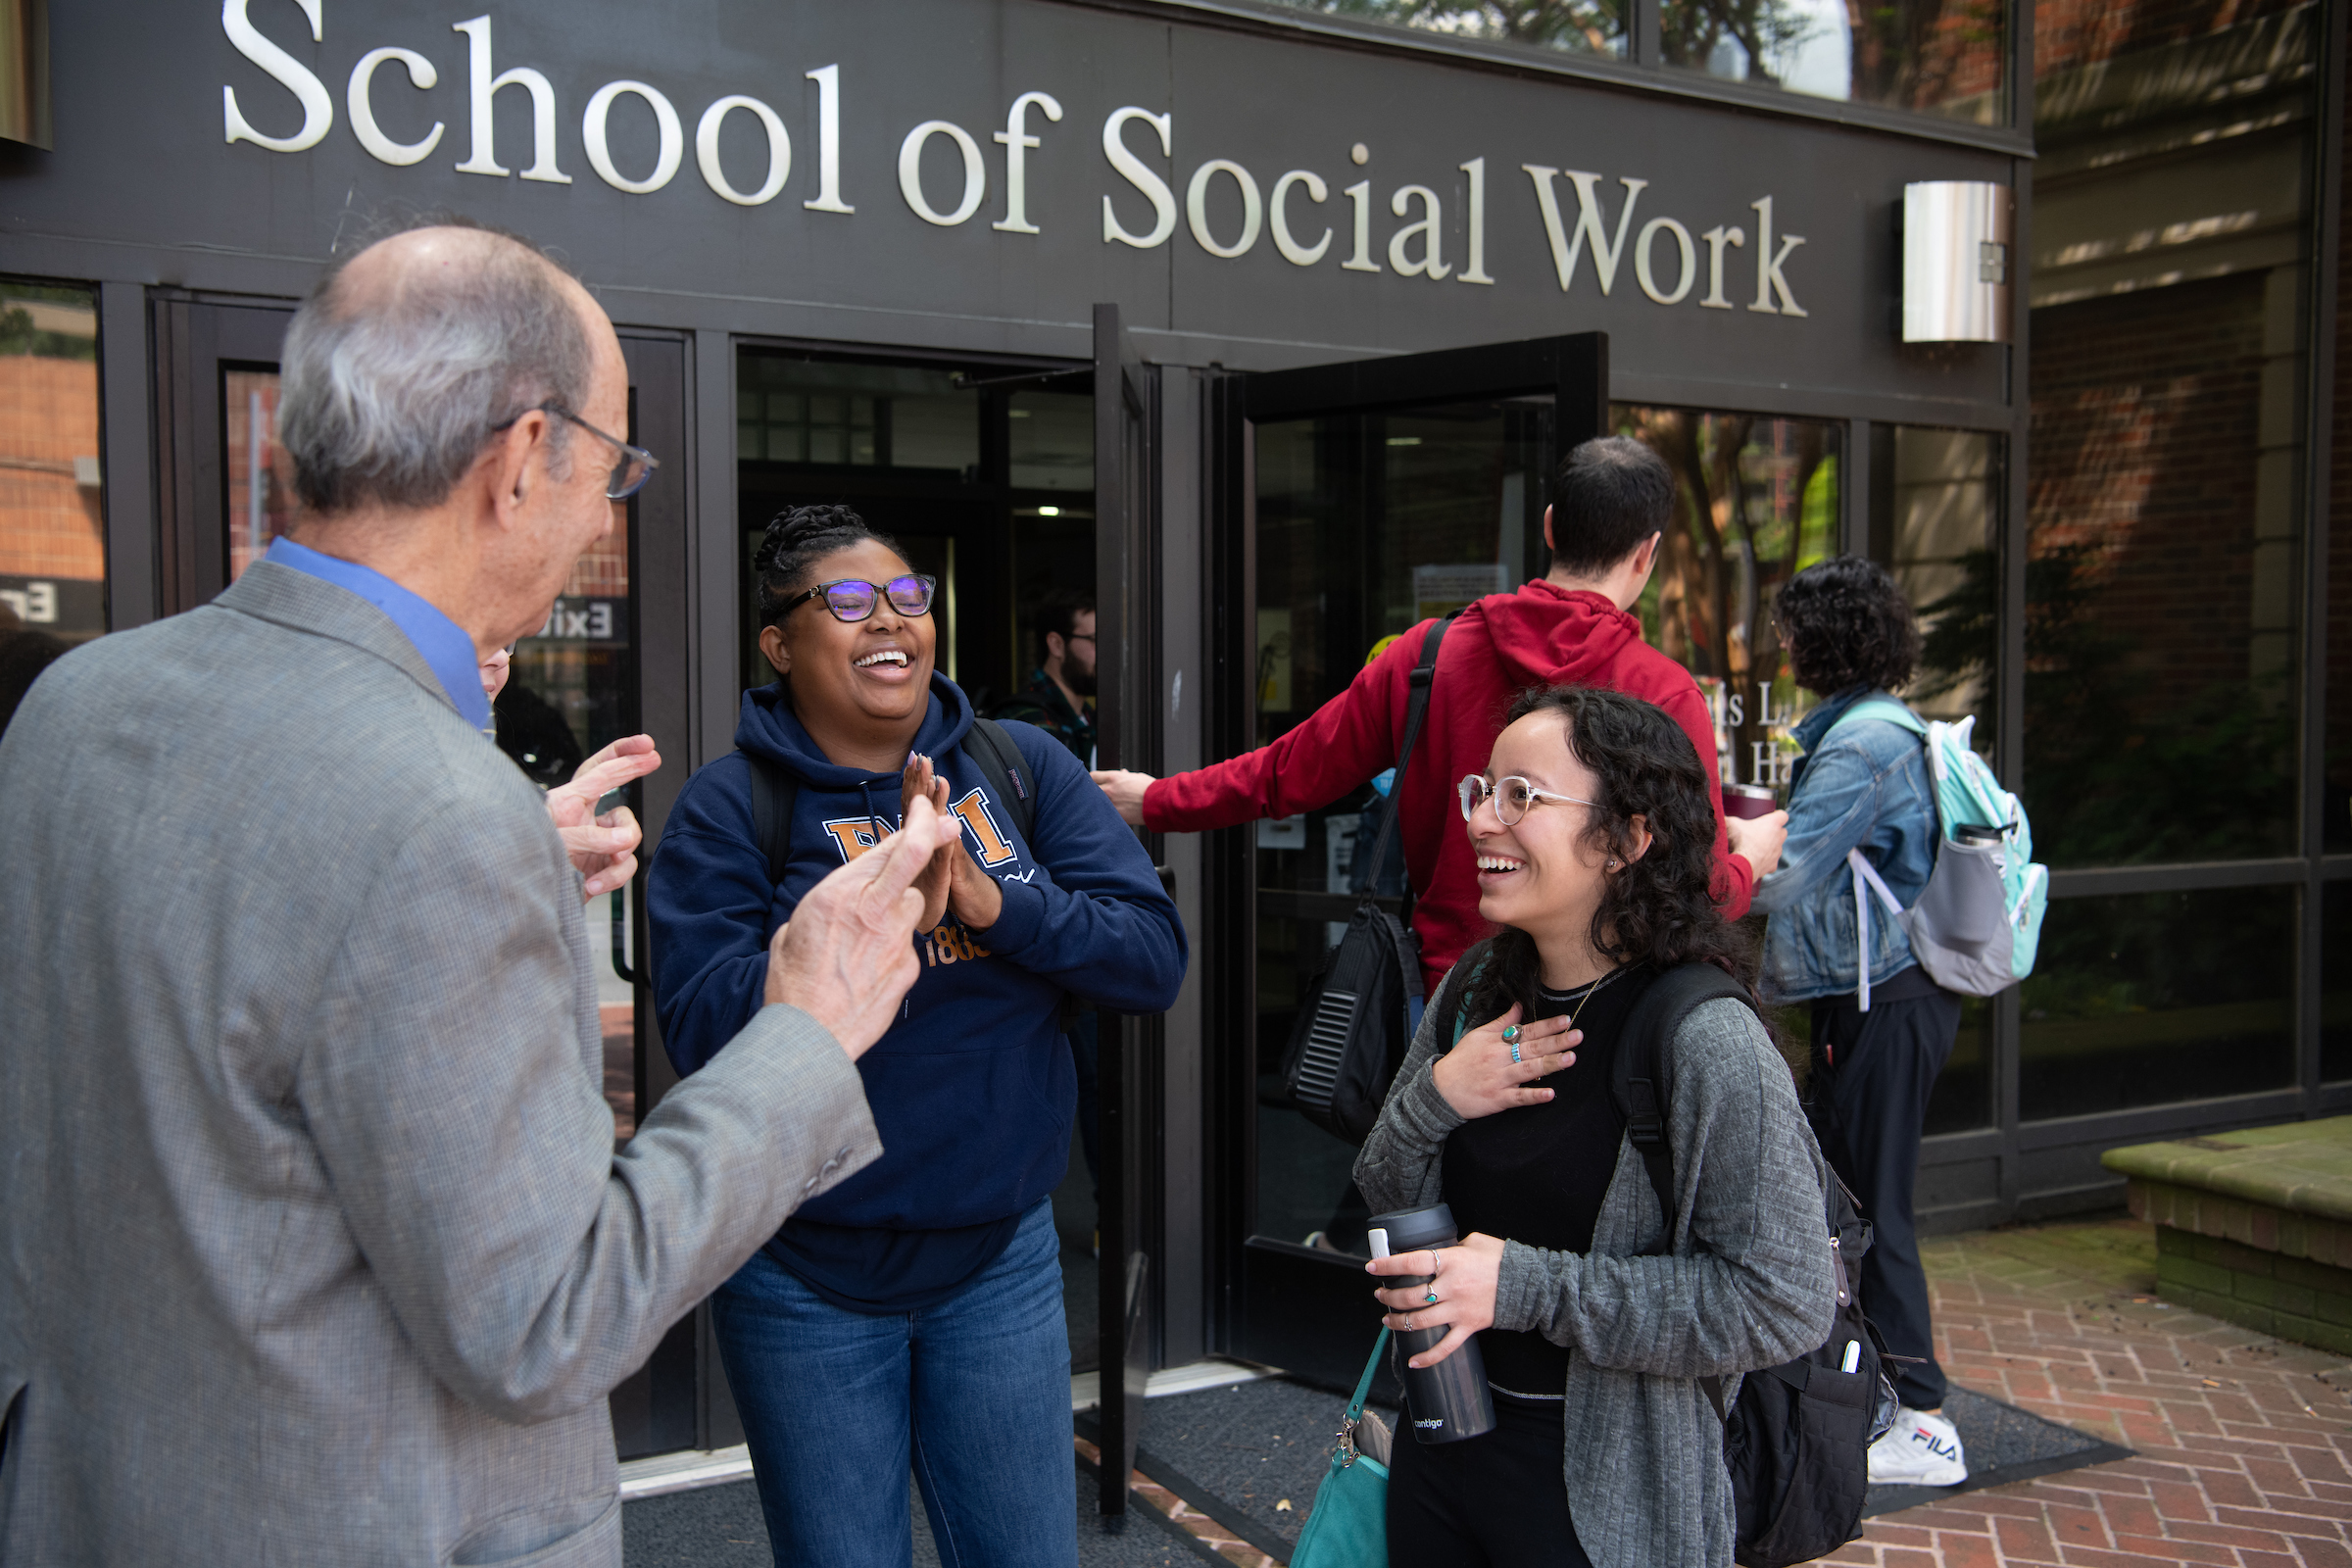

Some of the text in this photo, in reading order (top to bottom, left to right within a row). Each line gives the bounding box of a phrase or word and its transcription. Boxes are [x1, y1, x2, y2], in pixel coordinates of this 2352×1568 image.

[222, 0, 1808, 318] School of Social Work
[1414, 1418, 1444, 1430] contigo
[1913, 1427, 1956, 1462] FILA
